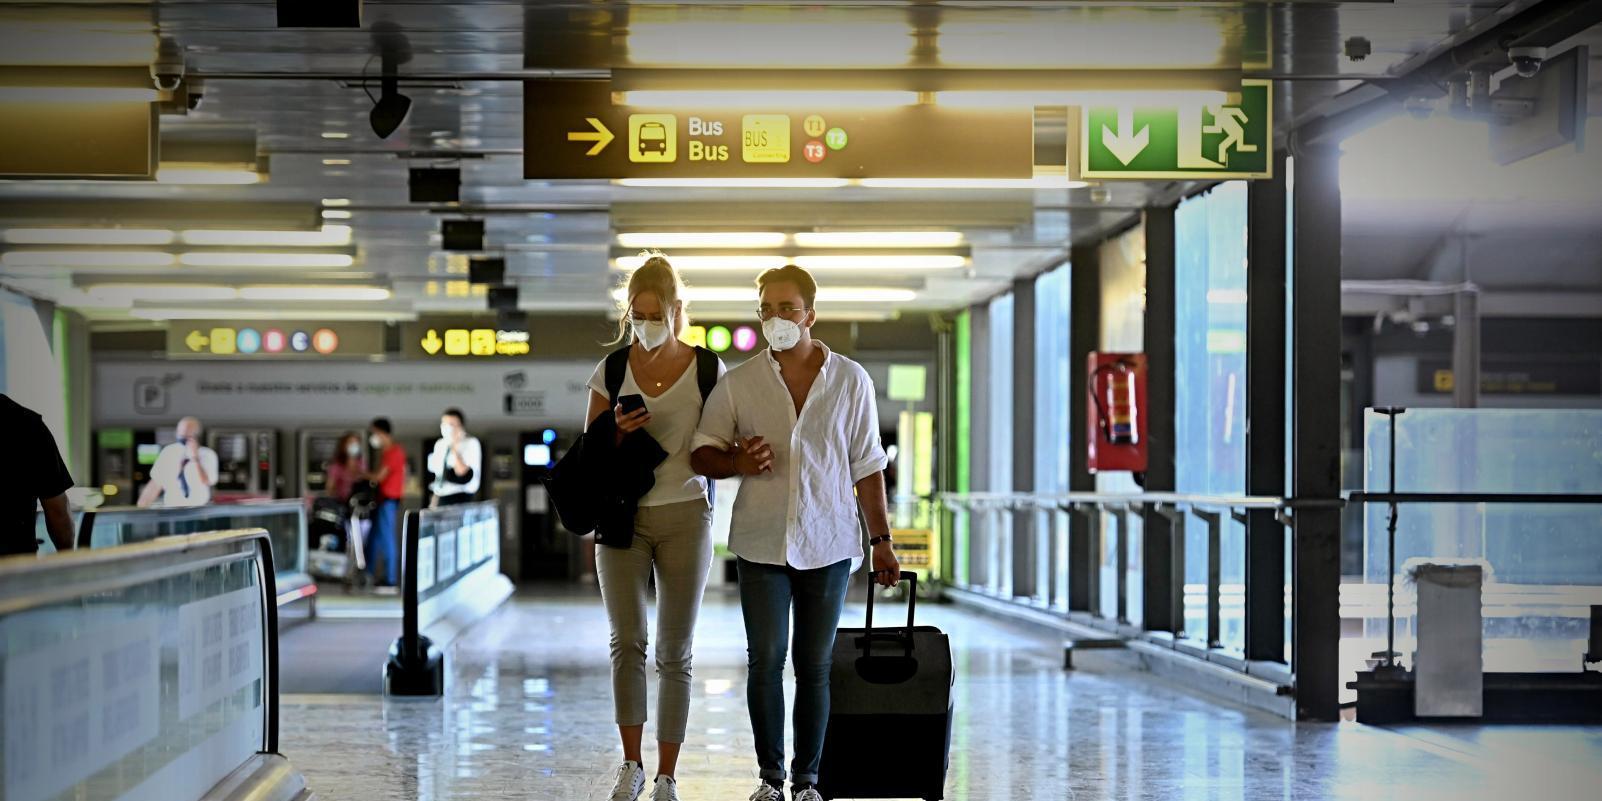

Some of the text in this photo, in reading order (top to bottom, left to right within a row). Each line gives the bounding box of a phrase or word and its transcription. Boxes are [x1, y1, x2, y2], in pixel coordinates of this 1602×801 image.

[689, 117, 723, 136] Bus
[807, 119, 822, 132] T1
[745, 130, 768, 147] BUS
[829, 131, 846, 145] T2
[689, 140, 729, 161] Bus
[806, 145, 824, 157] T3
